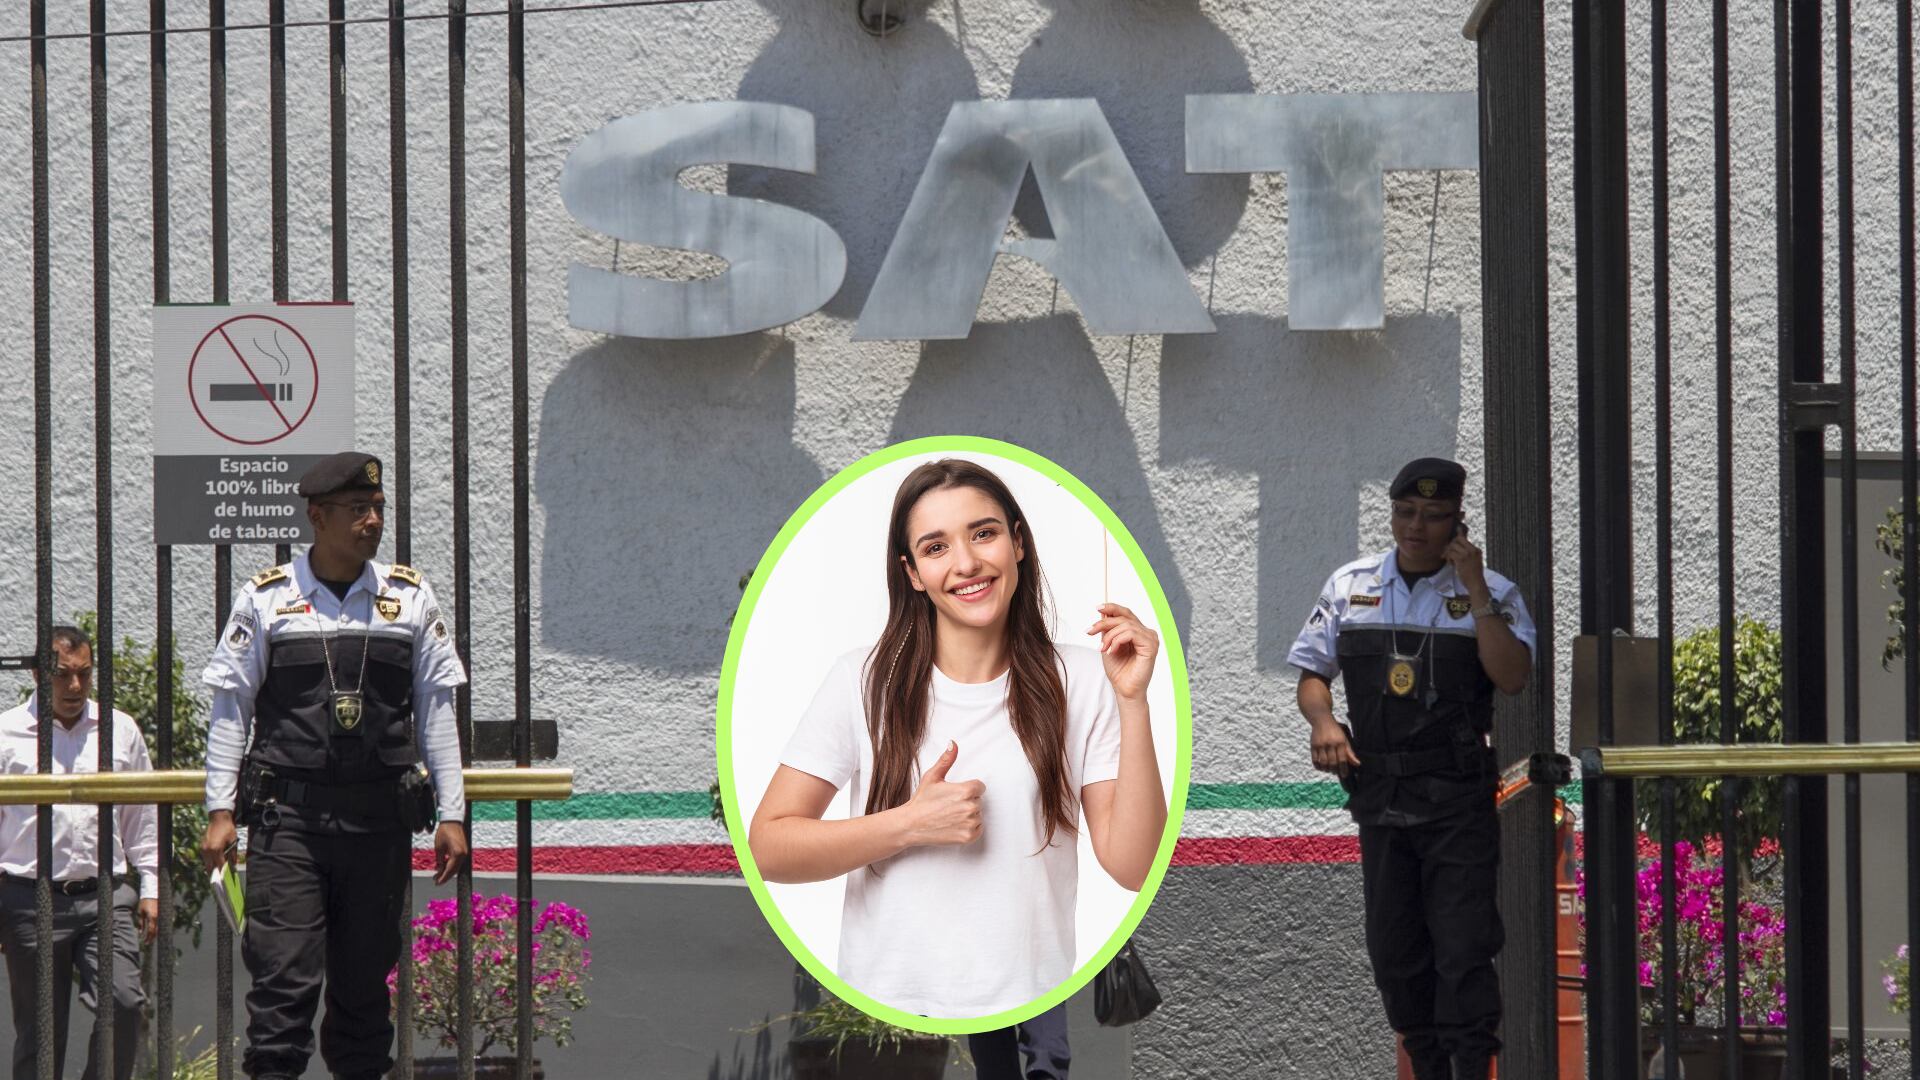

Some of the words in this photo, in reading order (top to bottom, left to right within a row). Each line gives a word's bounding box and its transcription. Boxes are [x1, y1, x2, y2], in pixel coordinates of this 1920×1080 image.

[559, 91, 1479, 341] SAT
[220, 457, 289, 477] Espacio
[205, 480, 257, 495] 100%
[262, 479, 300, 495] libre
[214, 501, 237, 517] de
[242, 501, 295, 517] humo
[209, 524, 231, 539] de
[236, 524, 300, 539] tabaco
